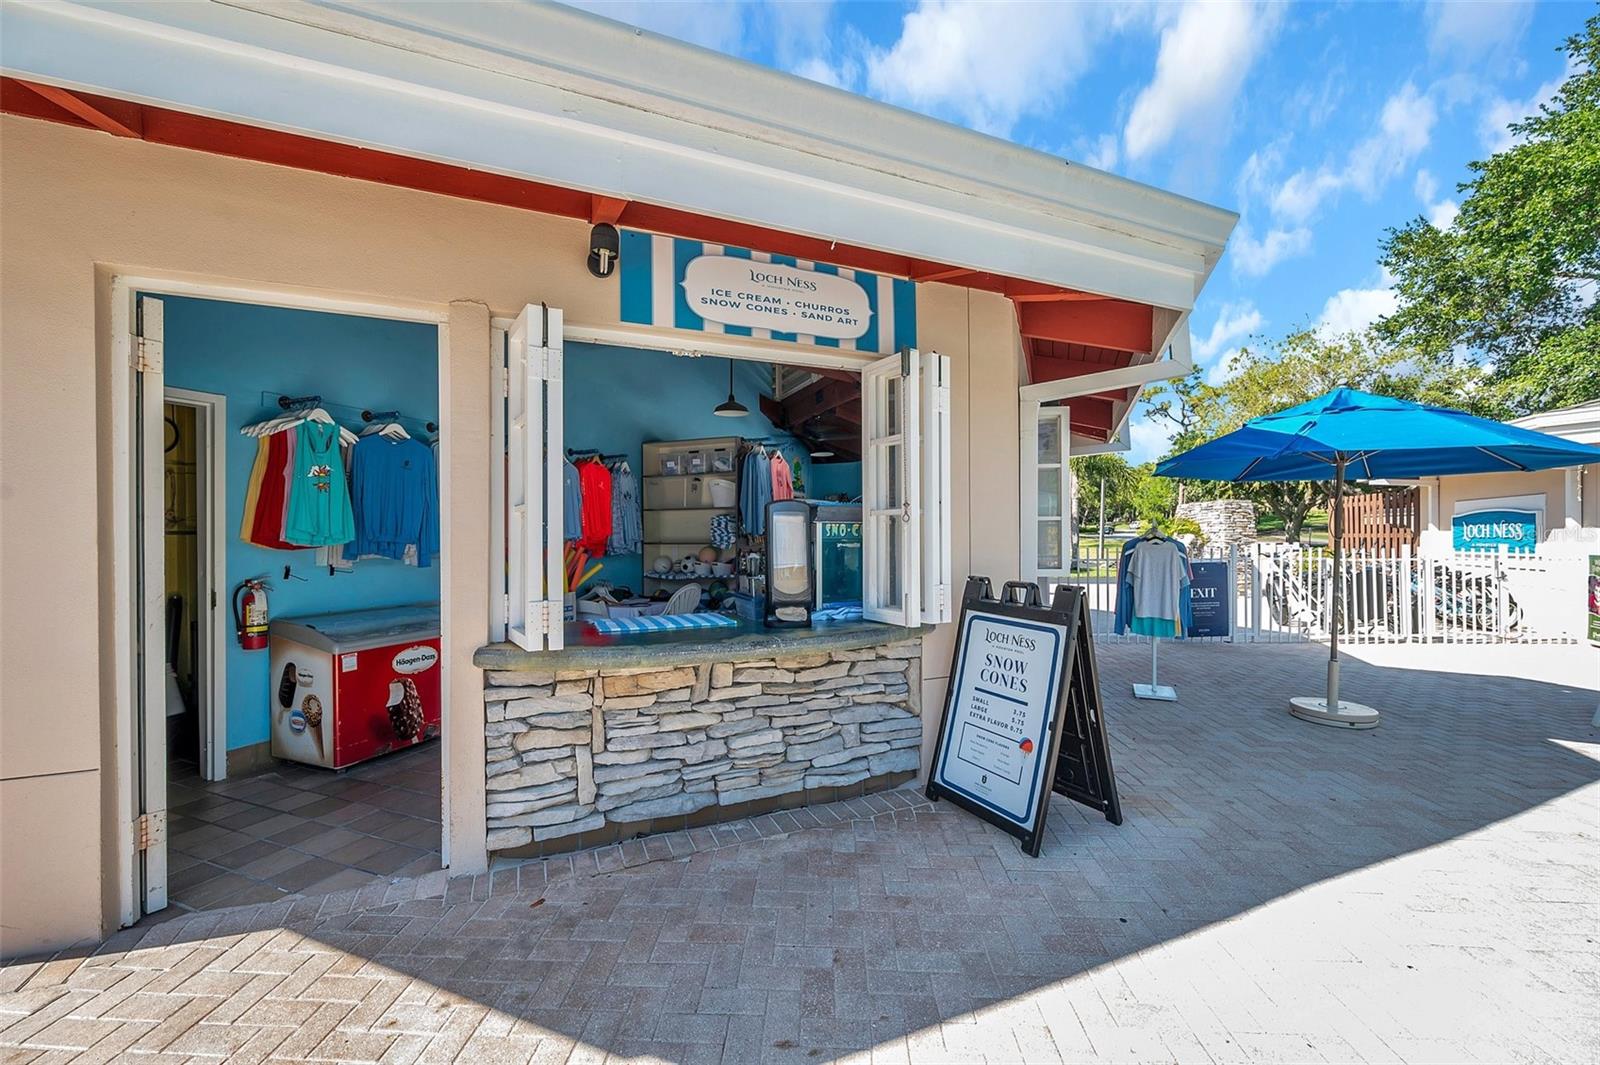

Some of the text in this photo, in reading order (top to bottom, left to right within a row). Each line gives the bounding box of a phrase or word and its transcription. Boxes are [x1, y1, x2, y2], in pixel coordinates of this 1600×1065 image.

[749, 269, 783, 285] LOCH
[787, 276, 817, 292] NESS
[700, 296, 859, 326] SNOW CONES SAND ART
[711, 288, 850, 316] ICE CREAM CHURROS
[1462, 519, 1524, 542] LOCH NESS
[1190, 587, 1217, 599] EXIT
[986, 627, 1036, 652] LOCH NESS
[984, 653, 1028, 675] SNOW
[980, 668, 1028, 693] CONES
[970, 703, 988, 714] LARGE
[972, 695, 989, 706] SMALL
[969, 710, 986, 722] EXTRA
[986, 717, 1009, 730] FLAVOR
